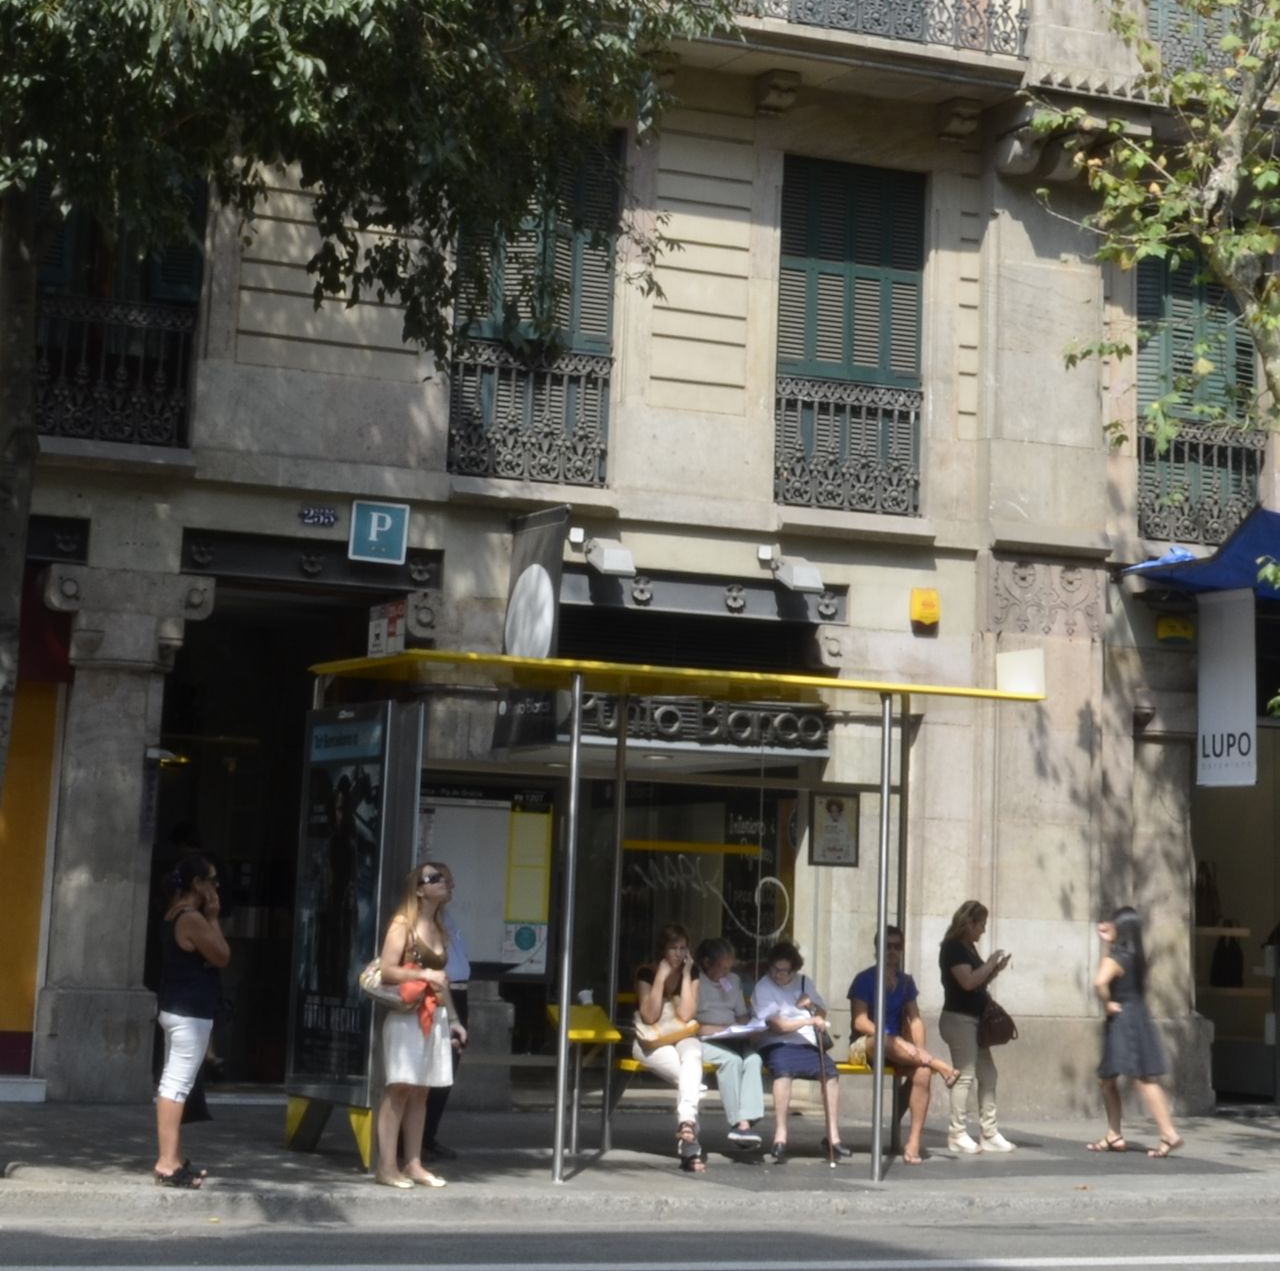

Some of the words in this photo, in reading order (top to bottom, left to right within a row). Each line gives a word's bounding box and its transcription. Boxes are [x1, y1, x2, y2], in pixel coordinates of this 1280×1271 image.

[304, 508, 335, 525] 255
[368, 511, 393, 542] P
[699, 698, 825, 742] Blanco
[1202, 732, 1251, 758] LUPO
